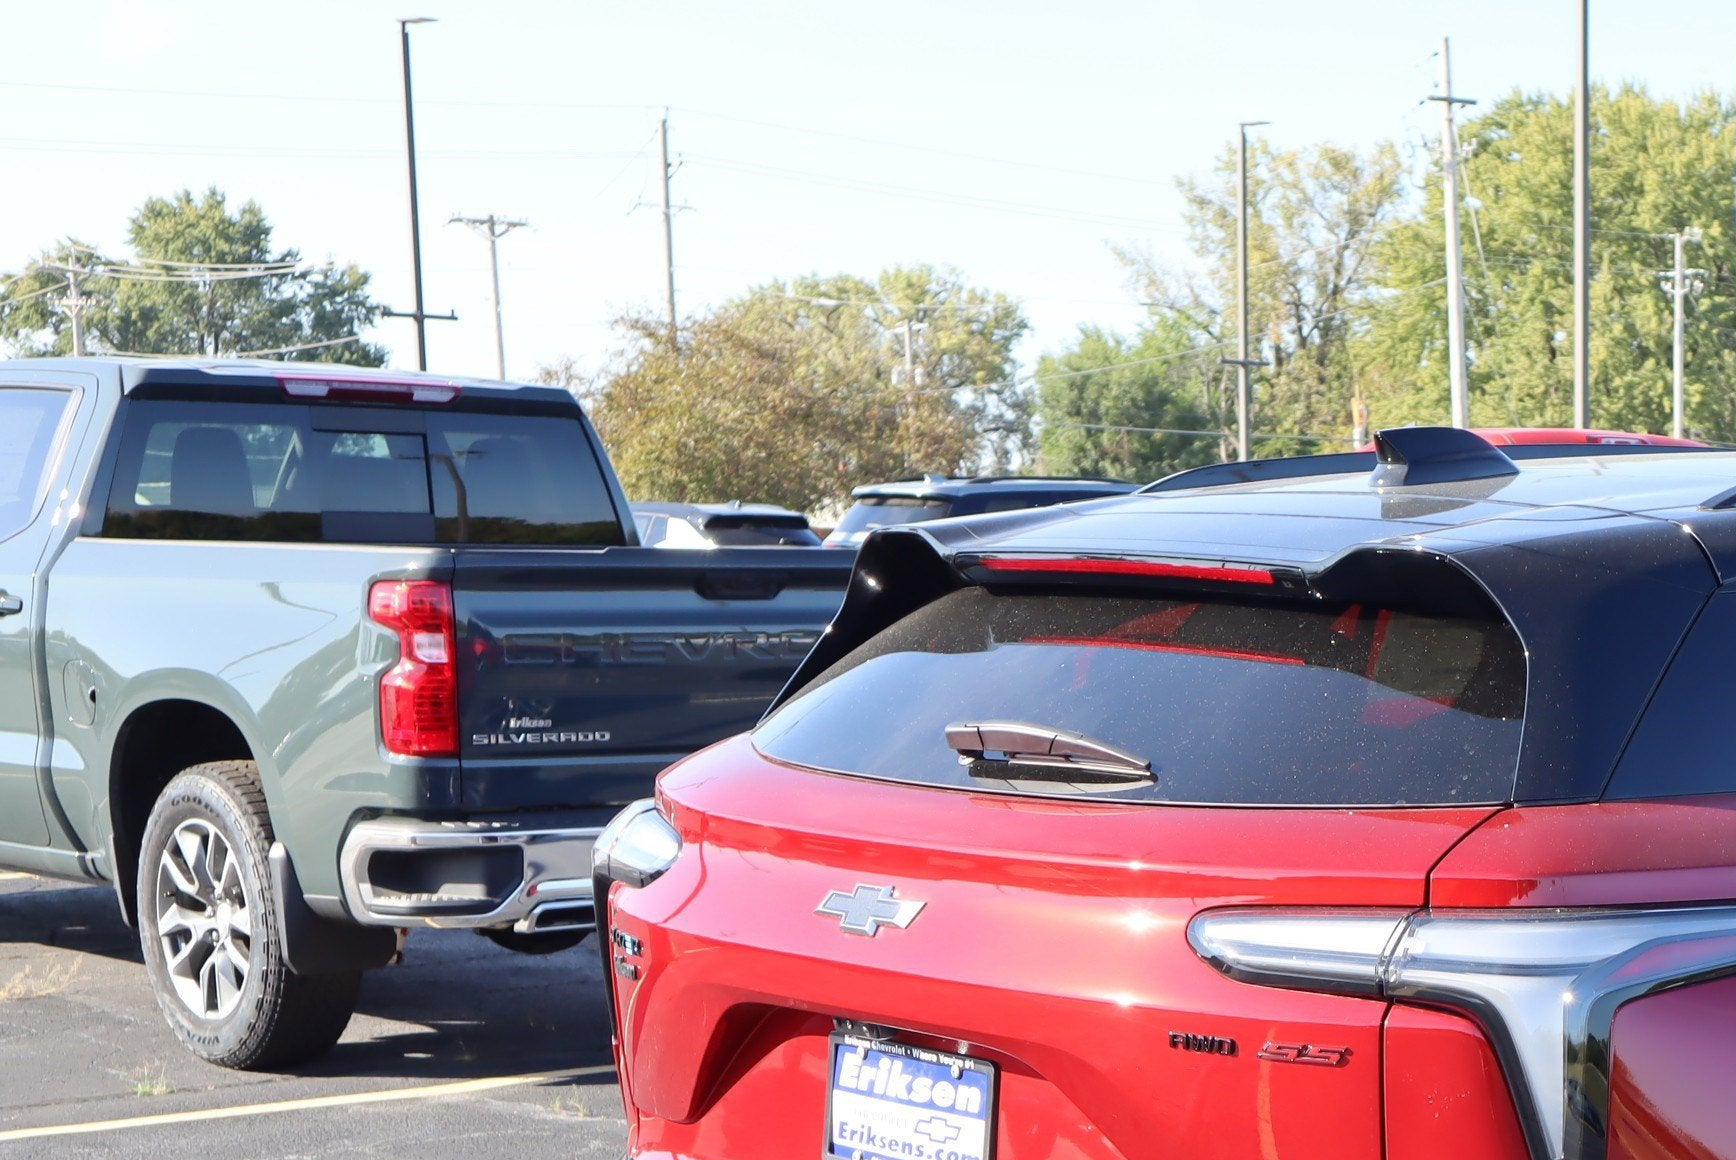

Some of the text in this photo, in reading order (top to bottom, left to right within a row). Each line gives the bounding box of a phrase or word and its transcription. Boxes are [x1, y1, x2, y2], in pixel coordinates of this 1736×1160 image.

[472, 730, 611, 746] SILVERADO
[871, 1040, 906, 1057] Chevrolet
[1168, 1030, 1353, 1067] AWD SS
[838, 1051, 983, 1114] Eriksen
